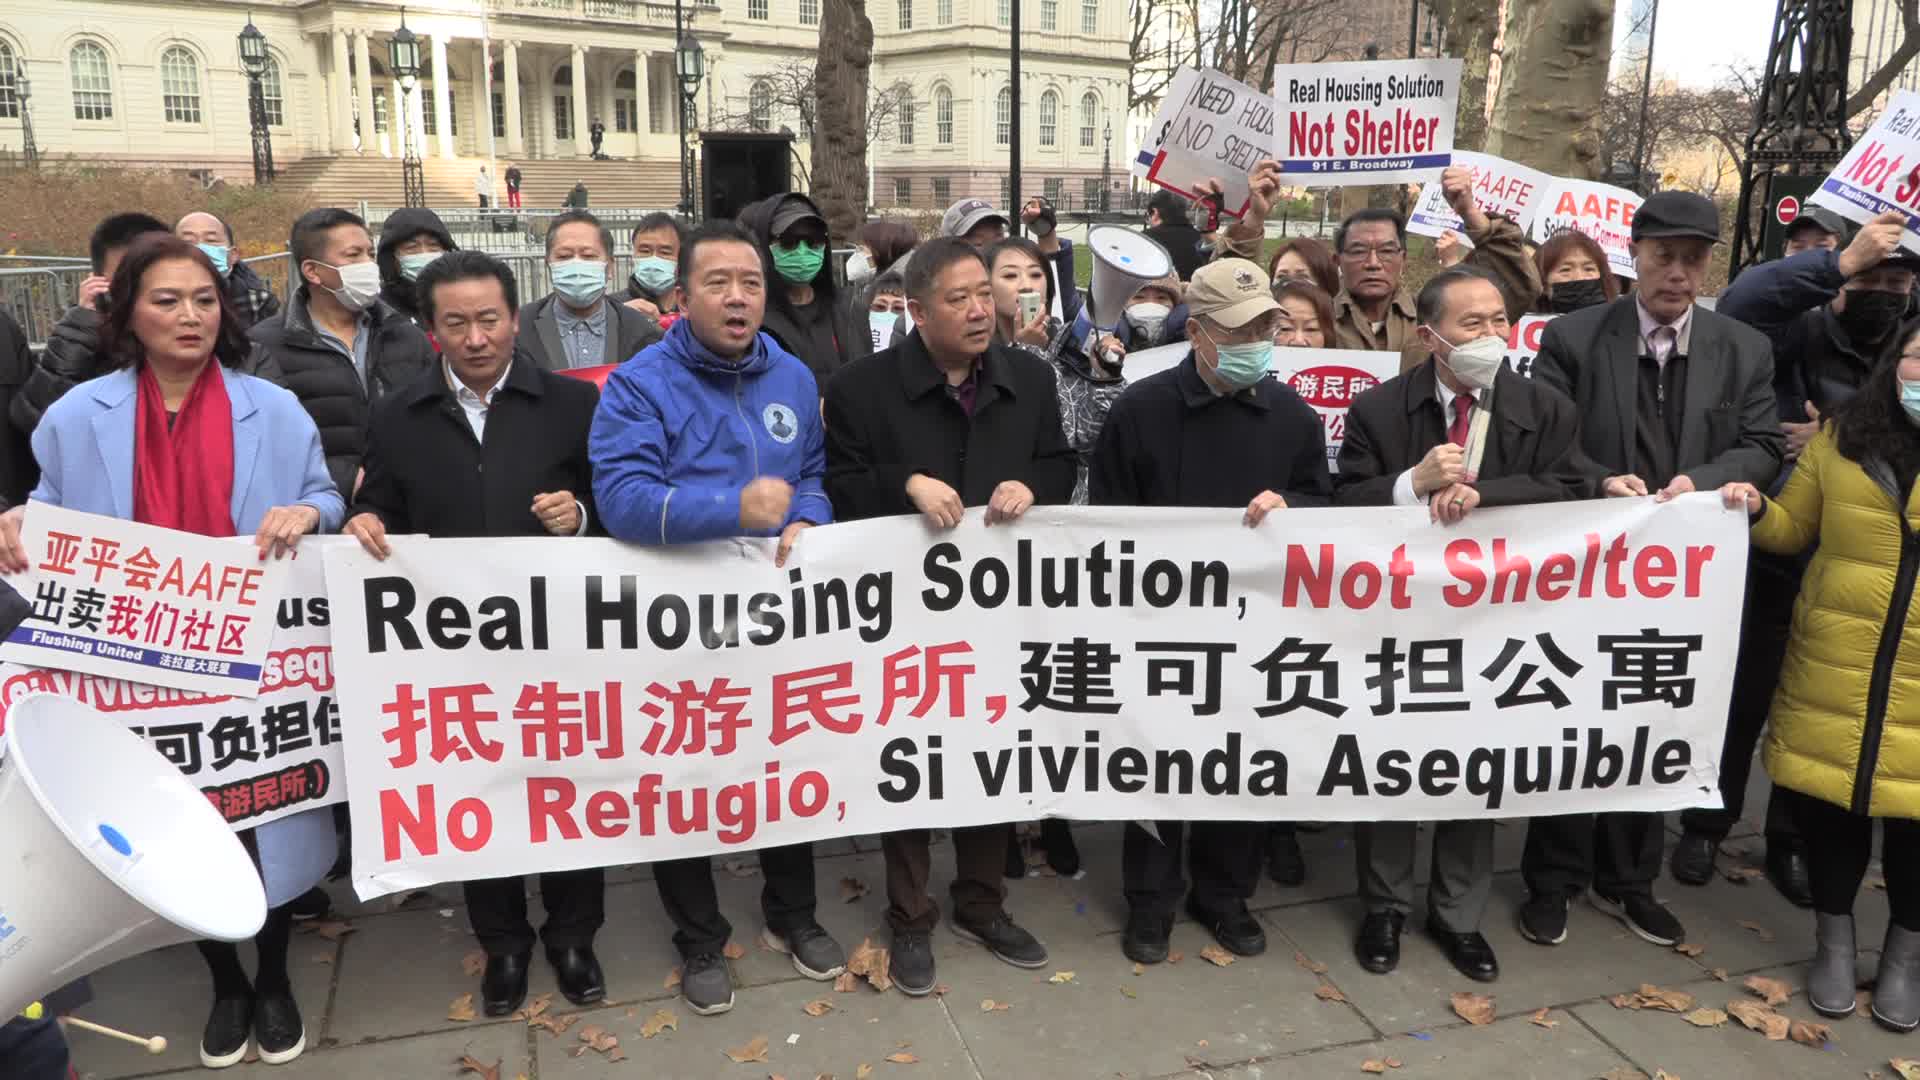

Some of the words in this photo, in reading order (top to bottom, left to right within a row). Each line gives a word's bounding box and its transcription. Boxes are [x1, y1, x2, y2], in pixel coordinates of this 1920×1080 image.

[1190, 77, 1235, 115] NEED
[1289, 79, 1320, 103] Real
[1326, 76, 1382, 107] Housing
[1387, 73, 1444, 101] Solution
[1175, 116, 1214, 151] NO
[1289, 111, 1335, 157] Not
[1344, 107, 1439, 156] Shelter
[1312, 161, 1328, 171] 91
[1333, 160, 1345, 171] E.
[1350, 158, 1414, 171] Broadway
[1843, 140, 1904, 194] Not
[1554, 191, 1636, 227] AAFE
[1837, 185, 1877, 211] Flushing
[1295, 374, 1376, 400] 游民所
[39, 531, 263, 606] 亚平会AAFE
[364, 575, 549, 653] Real
[584, 566, 893, 651] Housing
[921, 538, 1247, 620] Solution,
[1281, 543, 1415, 610] Not
[1442, 530, 1715, 608] Shelter
[31, 580, 251, 656] 出卖我们社区
[32, 630, 92, 654] Flushing
[96, 641, 144, 662] United
[159, 653, 231, 675] 法拉盛大联盟
[379, 783, 494, 863] No
[526, 760, 847, 845] Refugio,
[877, 734, 944, 804] Si
[972, 728, 1289, 797] vivienda
[1316, 725, 1692, 810] Asequible
